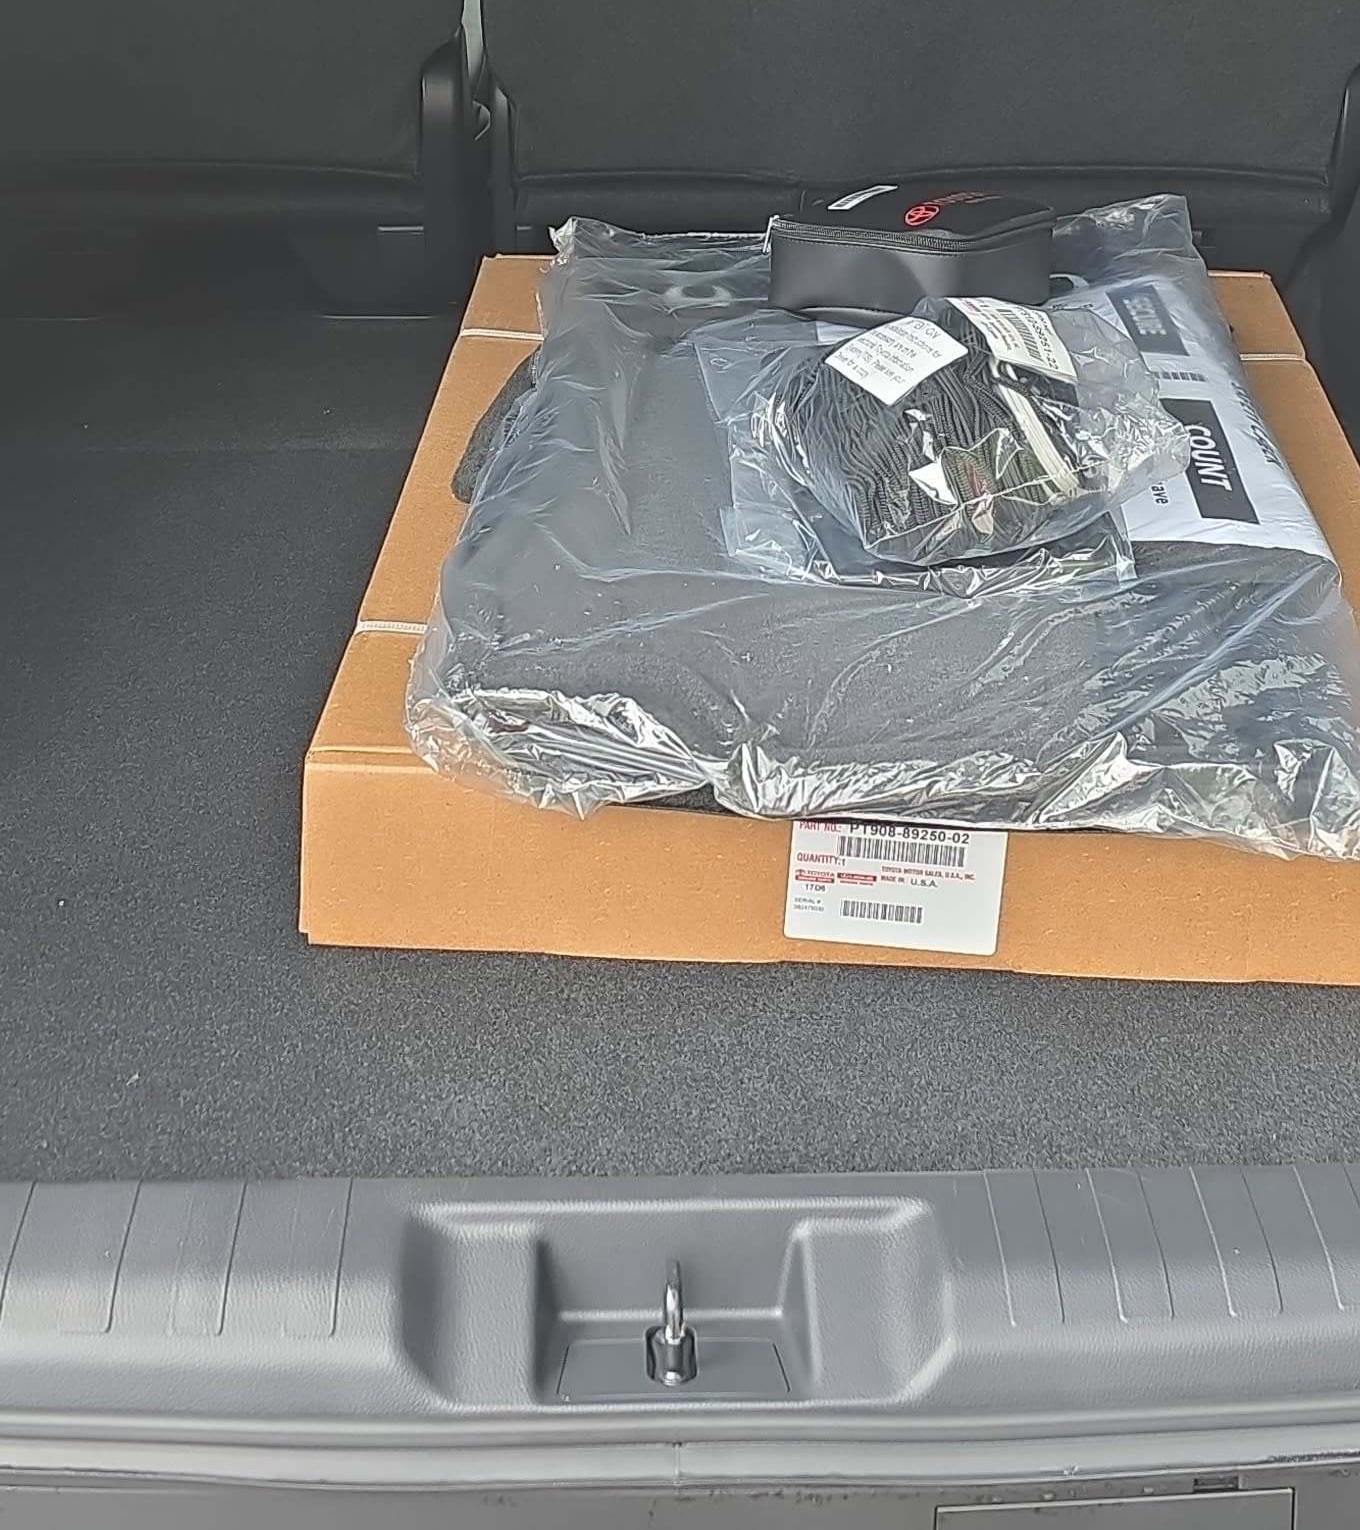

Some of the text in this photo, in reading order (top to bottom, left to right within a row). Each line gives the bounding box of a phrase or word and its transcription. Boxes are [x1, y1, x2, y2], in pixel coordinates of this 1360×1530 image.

[1184, 424, 1233, 492] COUNT
[1151, 480, 1170, 505] ave
[849, 822, 971, 845] PT908-89250-02
